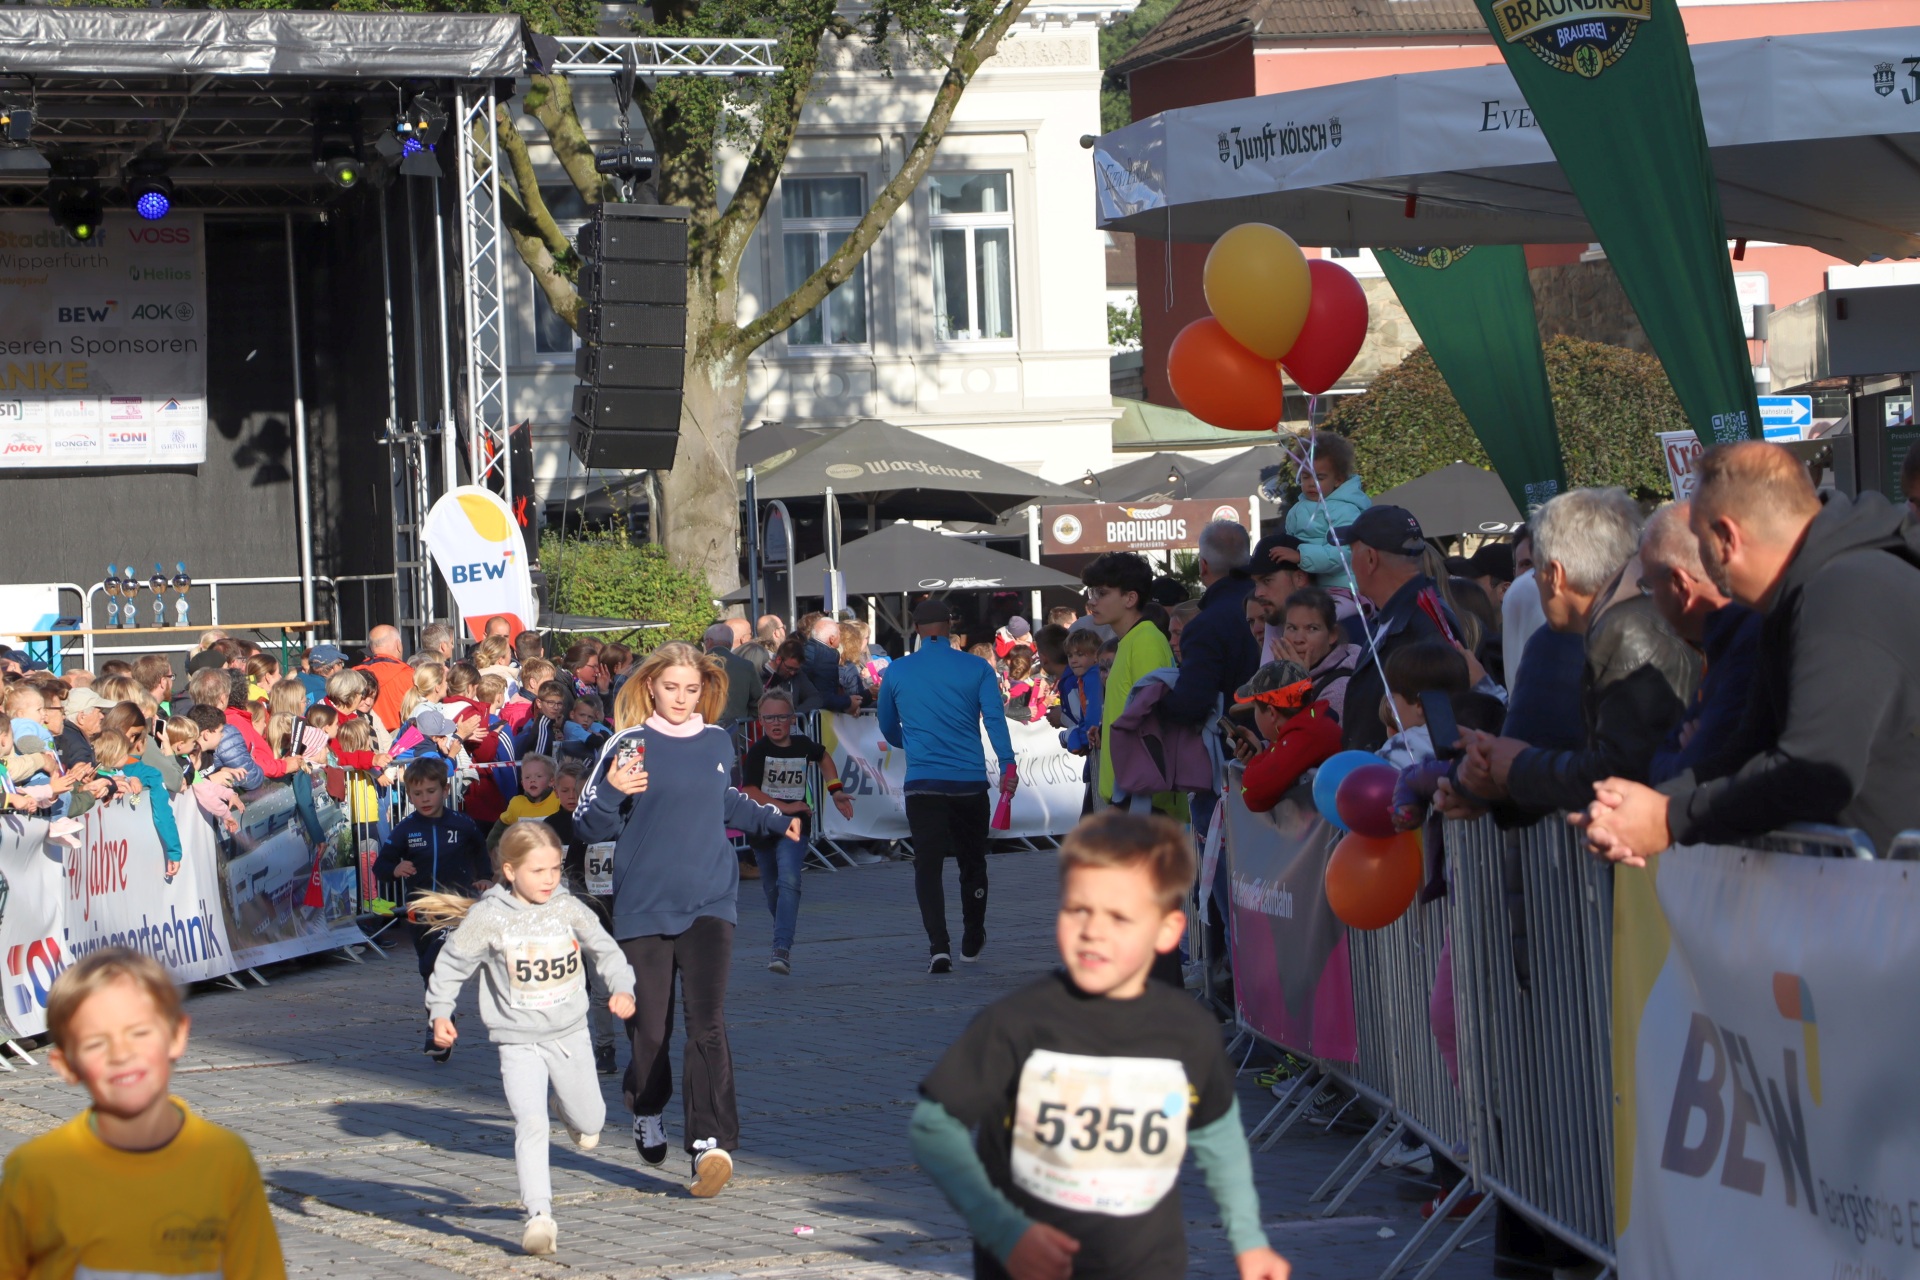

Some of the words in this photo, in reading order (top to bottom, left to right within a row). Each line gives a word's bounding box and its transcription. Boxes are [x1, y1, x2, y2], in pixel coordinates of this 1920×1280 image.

[1557, 22, 1607, 48] BRAUEREI
[1279, 121, 1327, 156] KÖLSCH
[128, 228, 190, 243] VOSS
[143, 268, 192, 280] Helios
[58, 306, 109, 322] BEW
[131, 304, 173, 320] AOK
[70, 335, 198, 357] Sponsoren
[1759, 407, 1794, 415] bahnstraße
[121, 431, 147, 442] ONI
[3, 443, 42, 454] jokey
[865, 459, 983, 480] Warsteiner
[1107, 519, 1187, 543] BRAUHAUS
[452, 559, 507, 584] BEW
[768, 769, 803, 784] 5475
[840, 755, 889, 796] BEW
[1042, 753, 1081, 785] uns.
[447, 830, 458, 843] 21
[84, 805, 128, 922] Jahre
[516, 951, 578, 982] 5355
[1034, 1101, 1169, 1155] 5356
